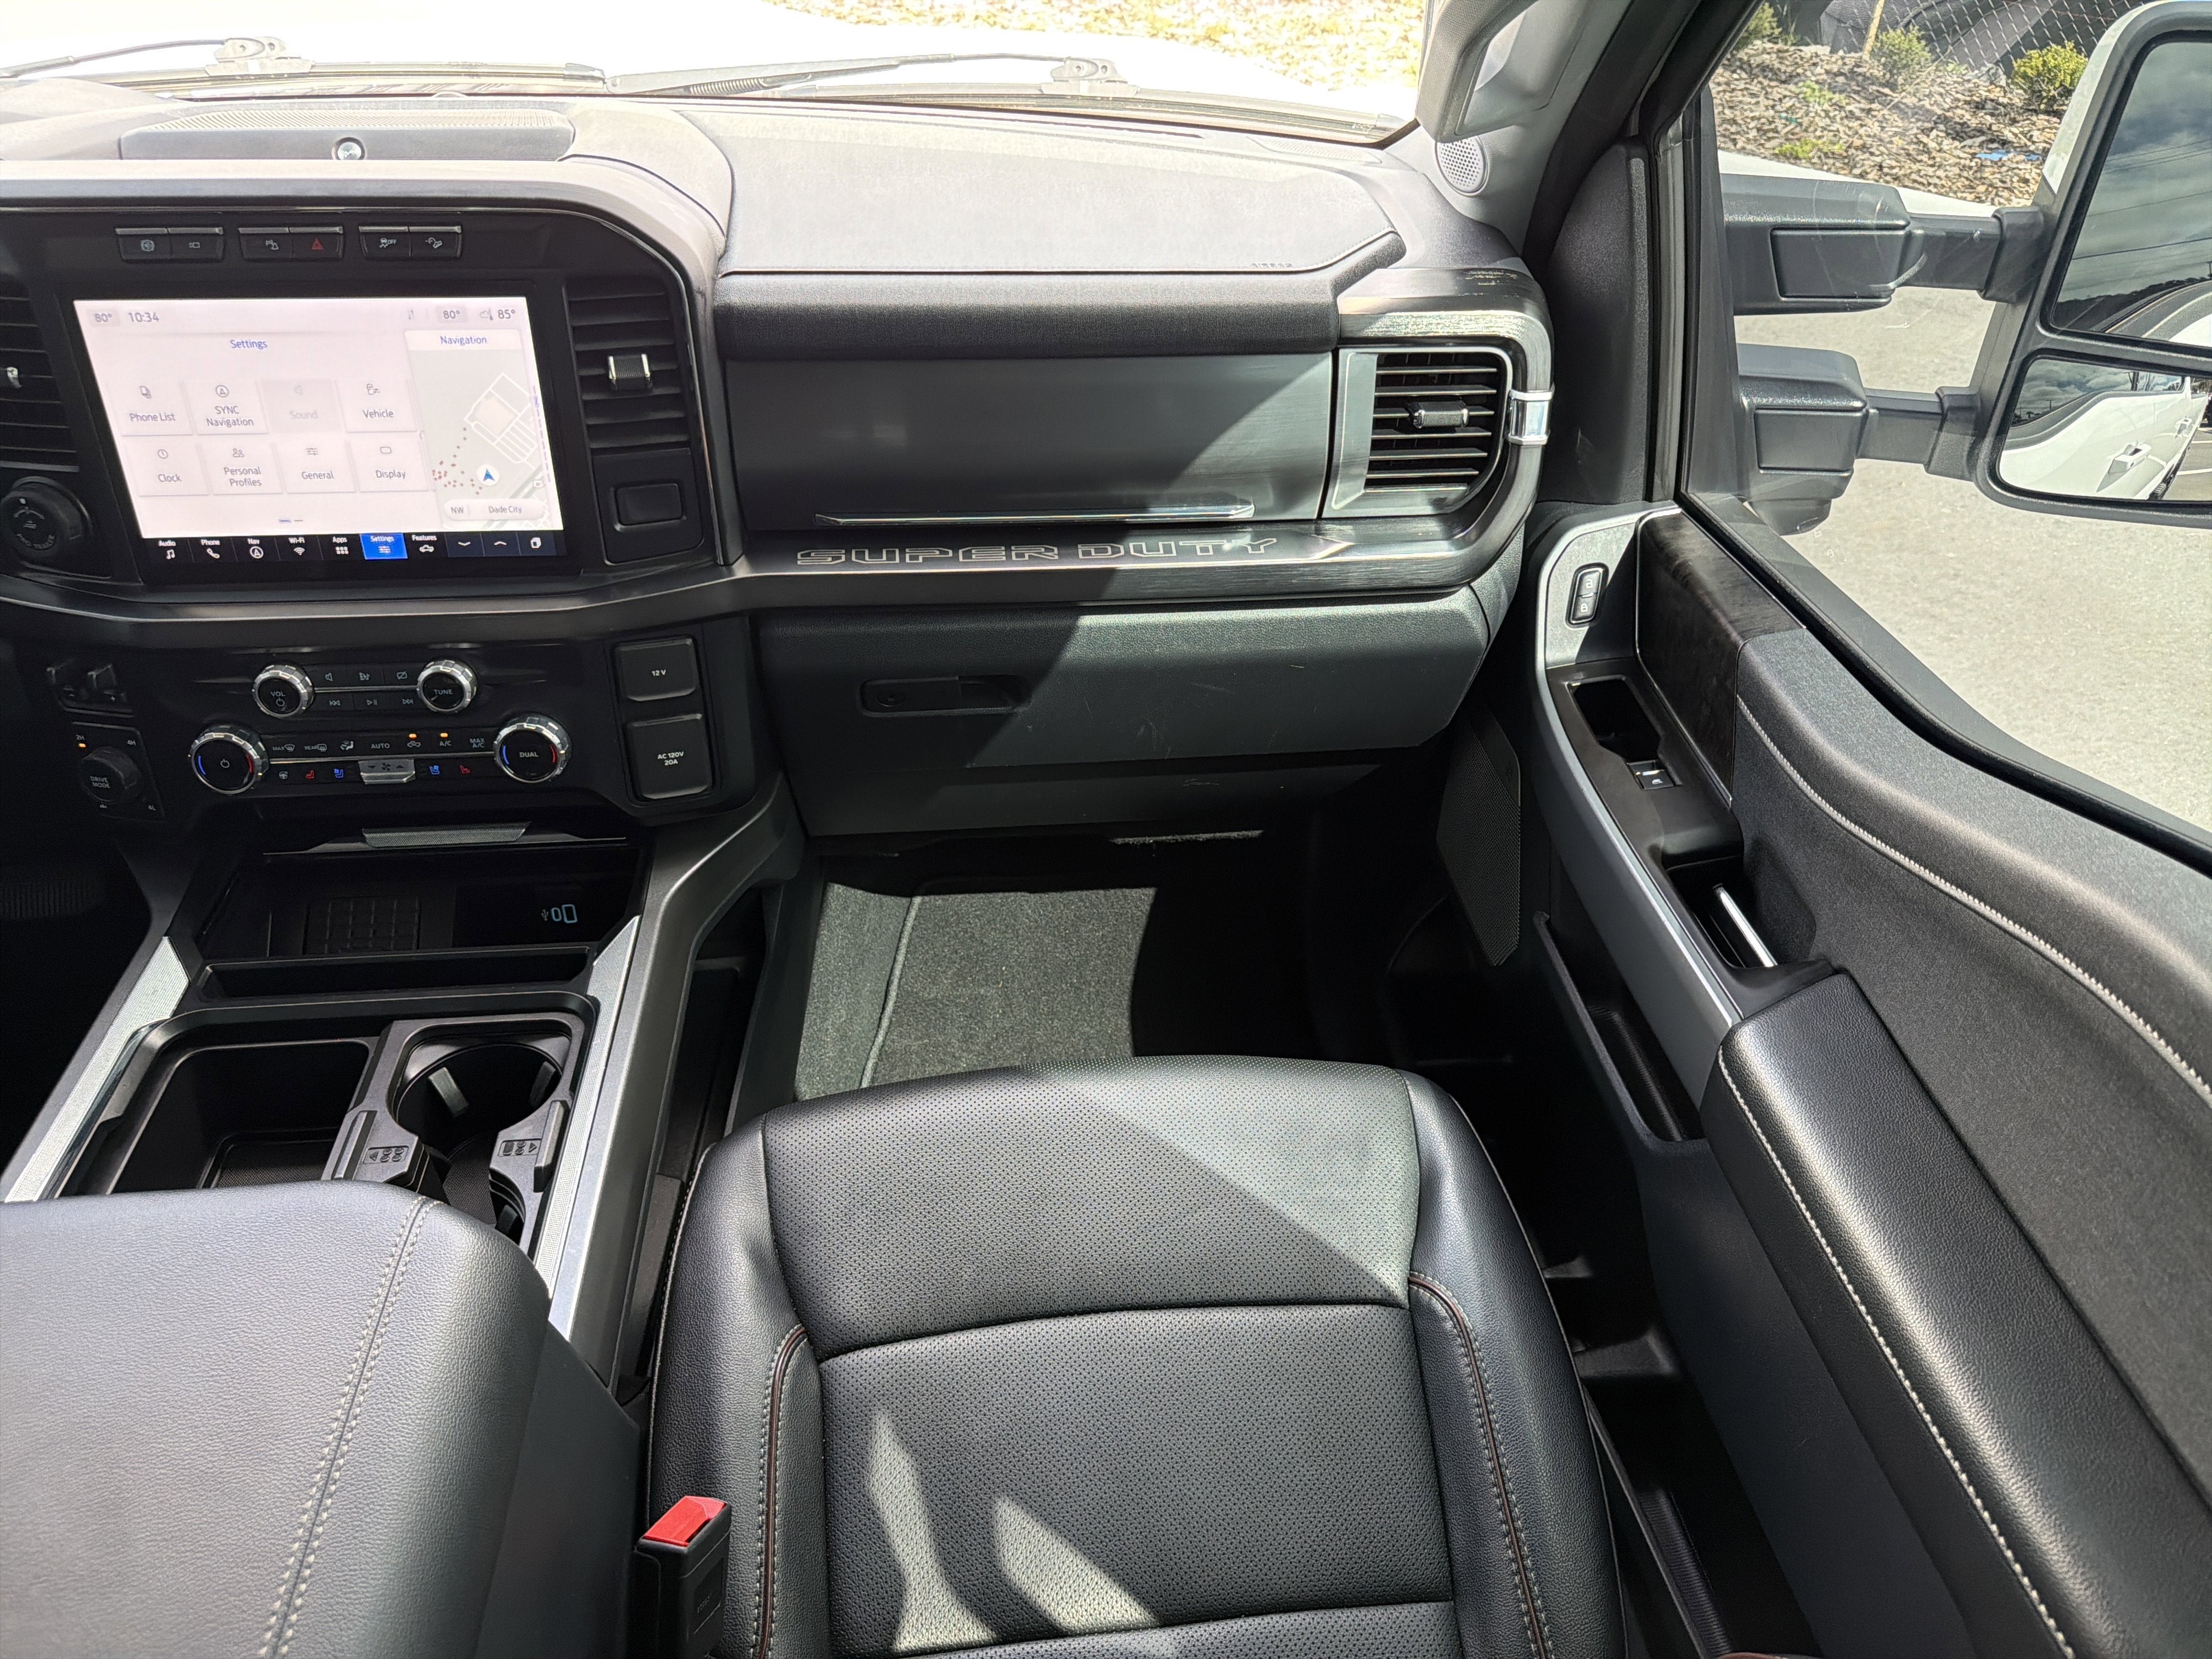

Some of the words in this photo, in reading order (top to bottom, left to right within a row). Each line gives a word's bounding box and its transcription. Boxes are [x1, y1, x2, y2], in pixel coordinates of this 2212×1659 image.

[129, 312, 159, 323] 10:34
[230, 338, 268, 350] Settings
[440, 335, 487, 346] Navigation
[215, 405, 239, 415] SYNC
[290, 410, 318, 420] Sound
[363, 409, 394, 418] Vehicle
[129, 413, 159, 422] Phone
[160, 412, 176, 422] List
[206, 417, 254, 428] Navigation
[224, 466, 261, 477] Personal
[302, 470, 334, 480] General
[375, 469, 406, 479] Display
[158, 473, 182, 483] Clock
[229, 477, 262, 488] Profiles
[451, 506, 464, 514] NW
[488, 505, 507, 514] Dade
[508, 505, 522, 514] City
[332, 536, 348, 544] Apps
[797, 543, 1059, 566] SUPER
[1078, 537, 1278, 561] DUTY
